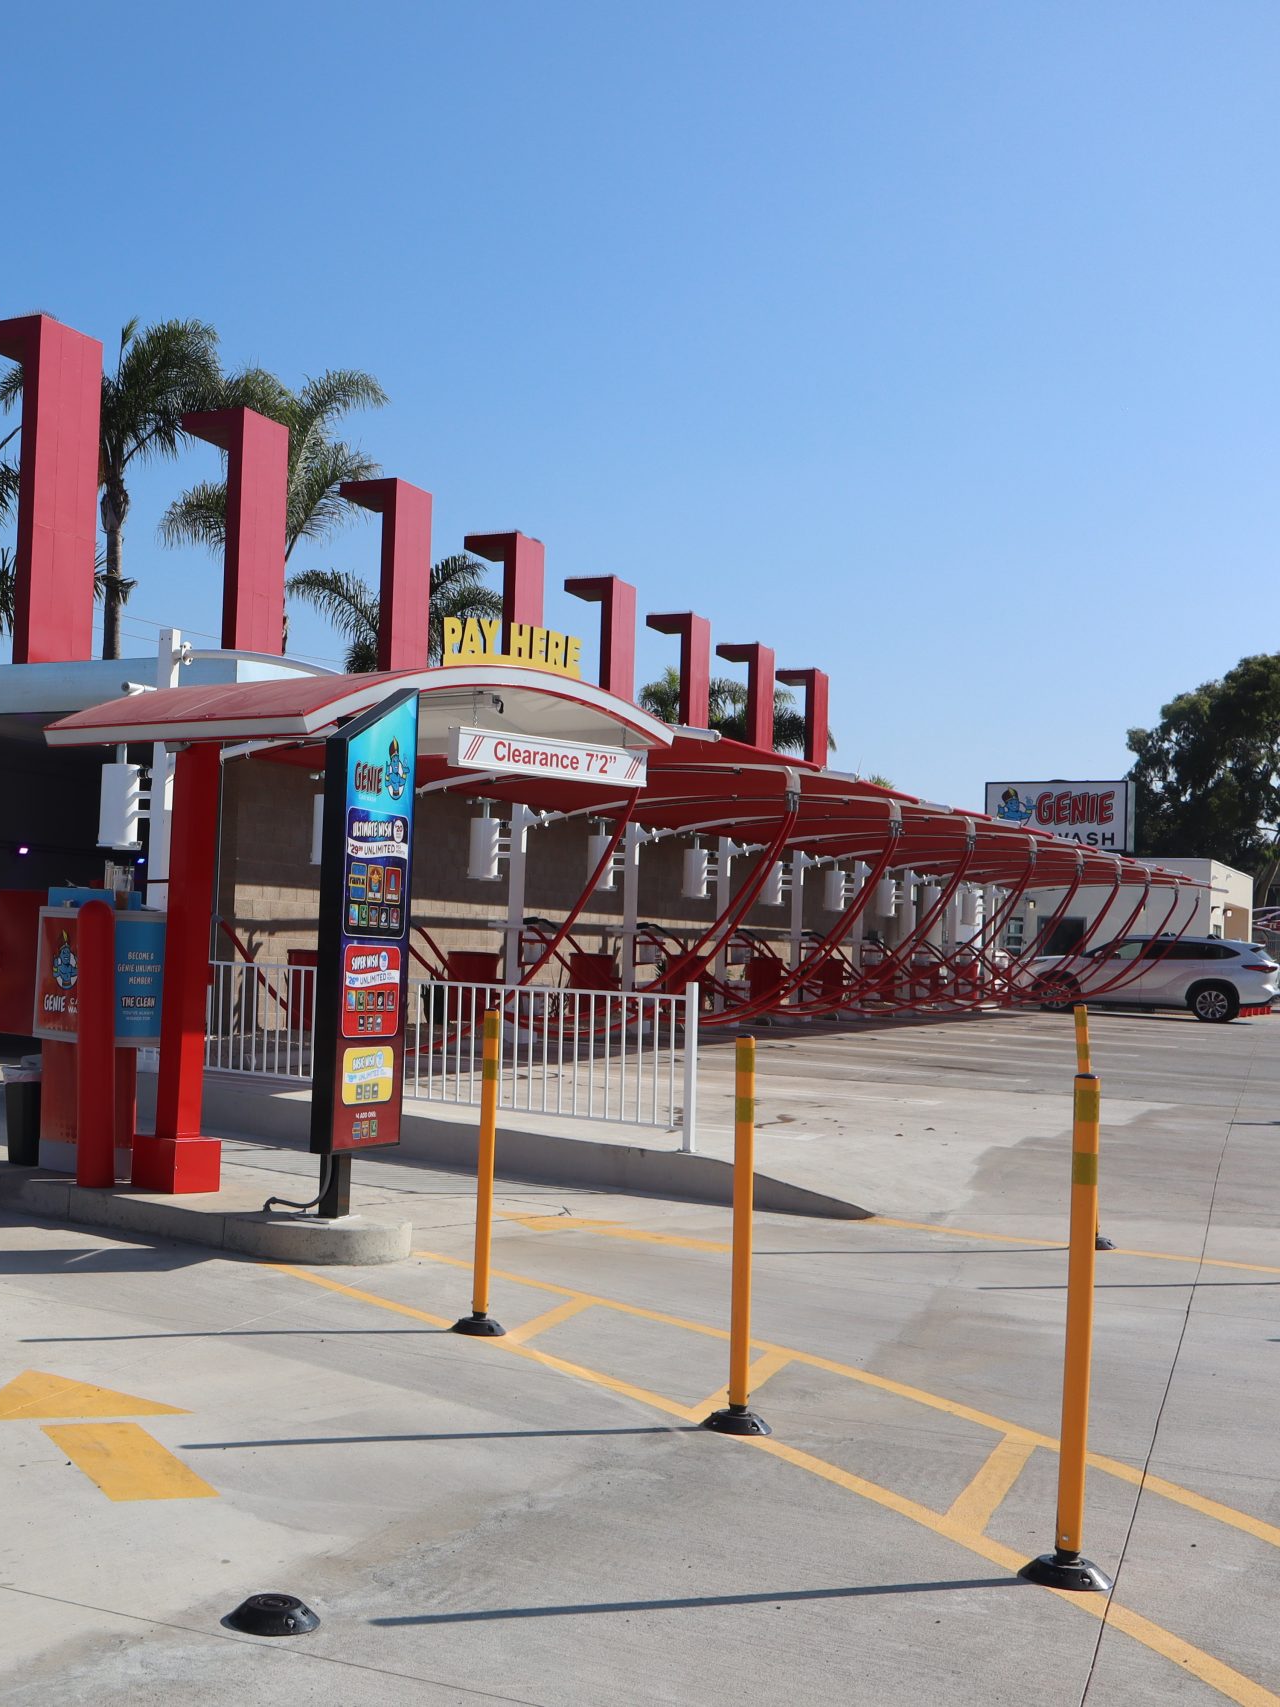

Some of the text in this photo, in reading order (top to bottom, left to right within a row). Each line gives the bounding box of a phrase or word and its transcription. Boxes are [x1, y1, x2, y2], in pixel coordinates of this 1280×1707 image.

[444, 617, 582, 668] PAY HERE
[493, 740, 579, 771] Clearance
[355, 760, 384, 796] GENIE
[1036, 791, 1115, 826] GENIE
[353, 821, 377, 837] ULTIMATE
[378, 822, 392, 837] WISH
[364, 845, 395, 855] UNLIMITED
[128, 951, 150, 960] BECOME
[352, 955, 366, 970] SUPER
[367, 954, 379, 968] WISH
[117, 963, 135, 972] GENIE
[44, 994, 66, 1012] GENIE
[121, 996, 155, 1008] THE CLEAN
